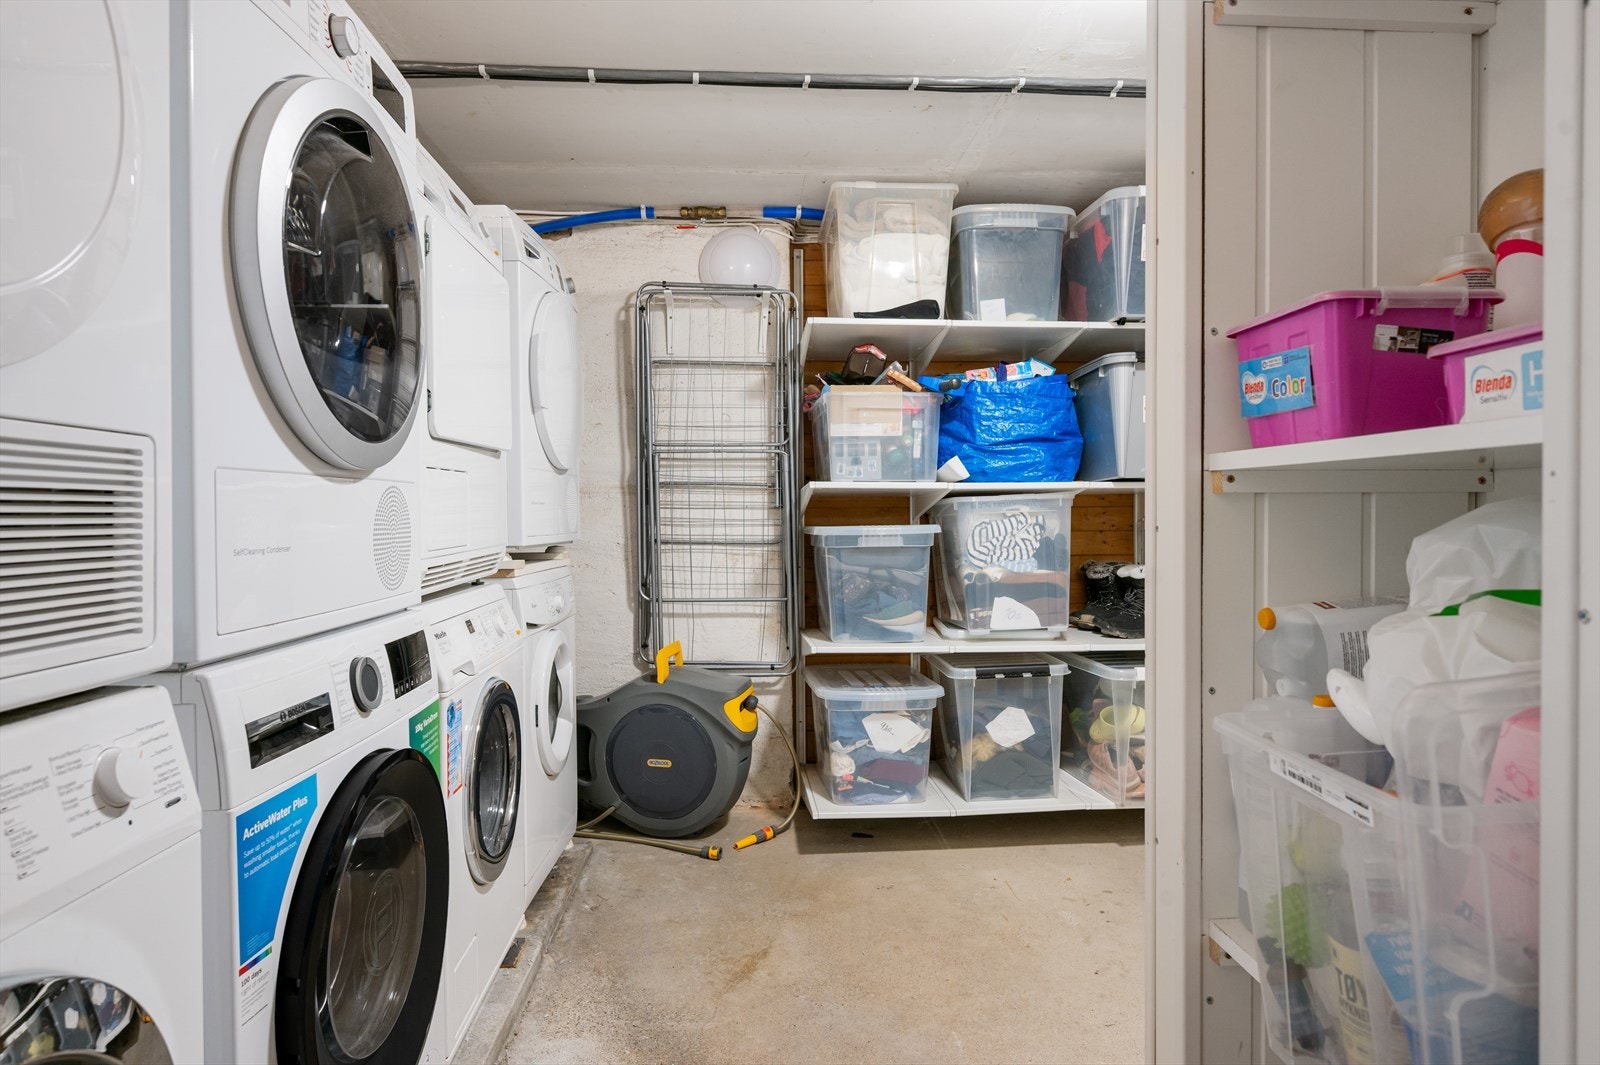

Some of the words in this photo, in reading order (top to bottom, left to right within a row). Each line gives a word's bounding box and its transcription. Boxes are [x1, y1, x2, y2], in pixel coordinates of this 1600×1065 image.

[1244, 380, 1264, 394] Blenda
[1272, 375, 1306, 398] Color
[1475, 374, 1512, 394] Blenda
[233, 547, 266, 557] SelfCleaning
[266, 546, 292, 554] Condenser
[287, 704, 306, 718] BOSCH
[243, 804, 292, 841] ActiveWater
[292, 796, 308, 811] Plus
[243, 847, 255, 858] Save
[241, 976, 251, 988] 100
[251, 968, 262, 979] days
[1334, 966, 1368, 1008] TØY
